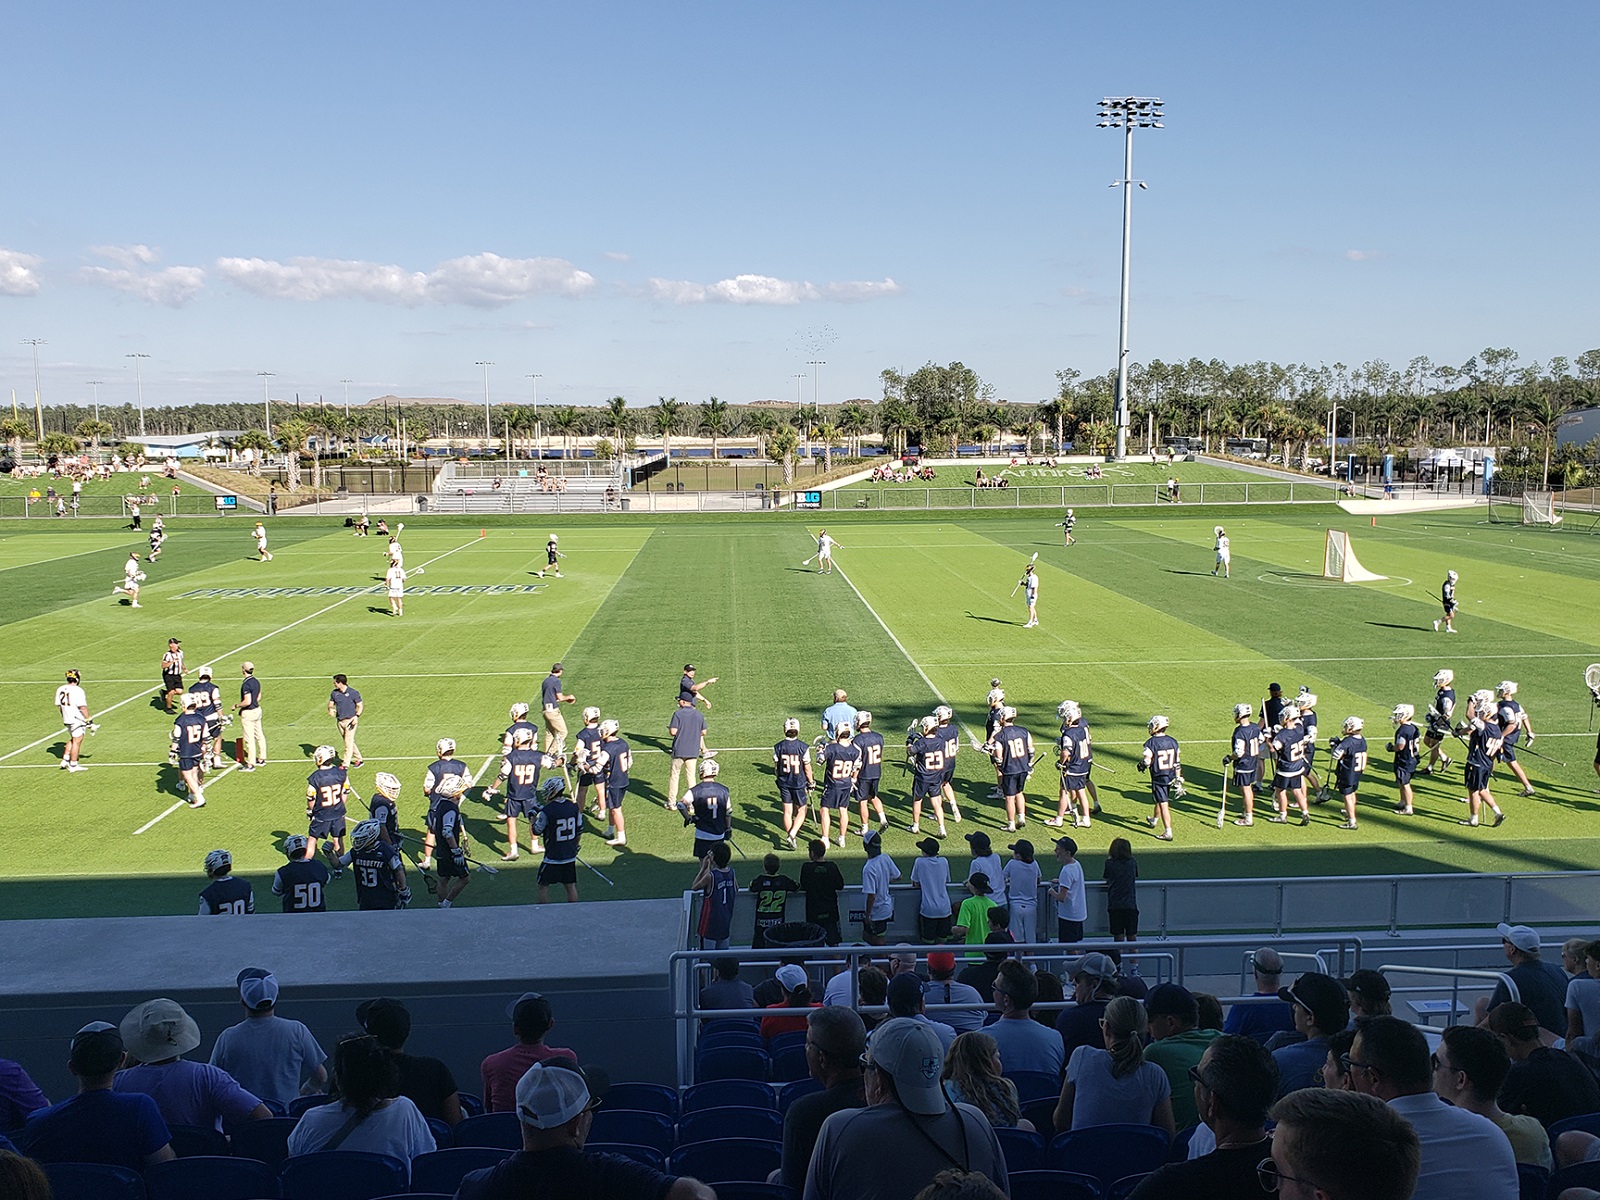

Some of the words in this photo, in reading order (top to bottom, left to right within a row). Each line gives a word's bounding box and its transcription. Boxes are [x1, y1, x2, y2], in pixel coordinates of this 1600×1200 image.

[60, 691, 71, 707] 21
[186, 724, 202, 744] 15
[866, 744, 882, 764] 12
[1008, 737, 1025, 759] 18
[781, 754, 801, 774] 34
[832, 759, 852, 779] 28
[924, 750, 945, 770] 23
[1157, 748, 1176, 771] 27
[514, 764, 536, 785] 49
[320, 783, 342, 808] 32
[707, 796, 719, 820] 4
[556, 816, 577, 842] 29
[360, 867, 378, 888] 33
[294, 882, 322, 909] 50
[722, 887, 728, 905] 1
[757, 890, 787, 913] 22
